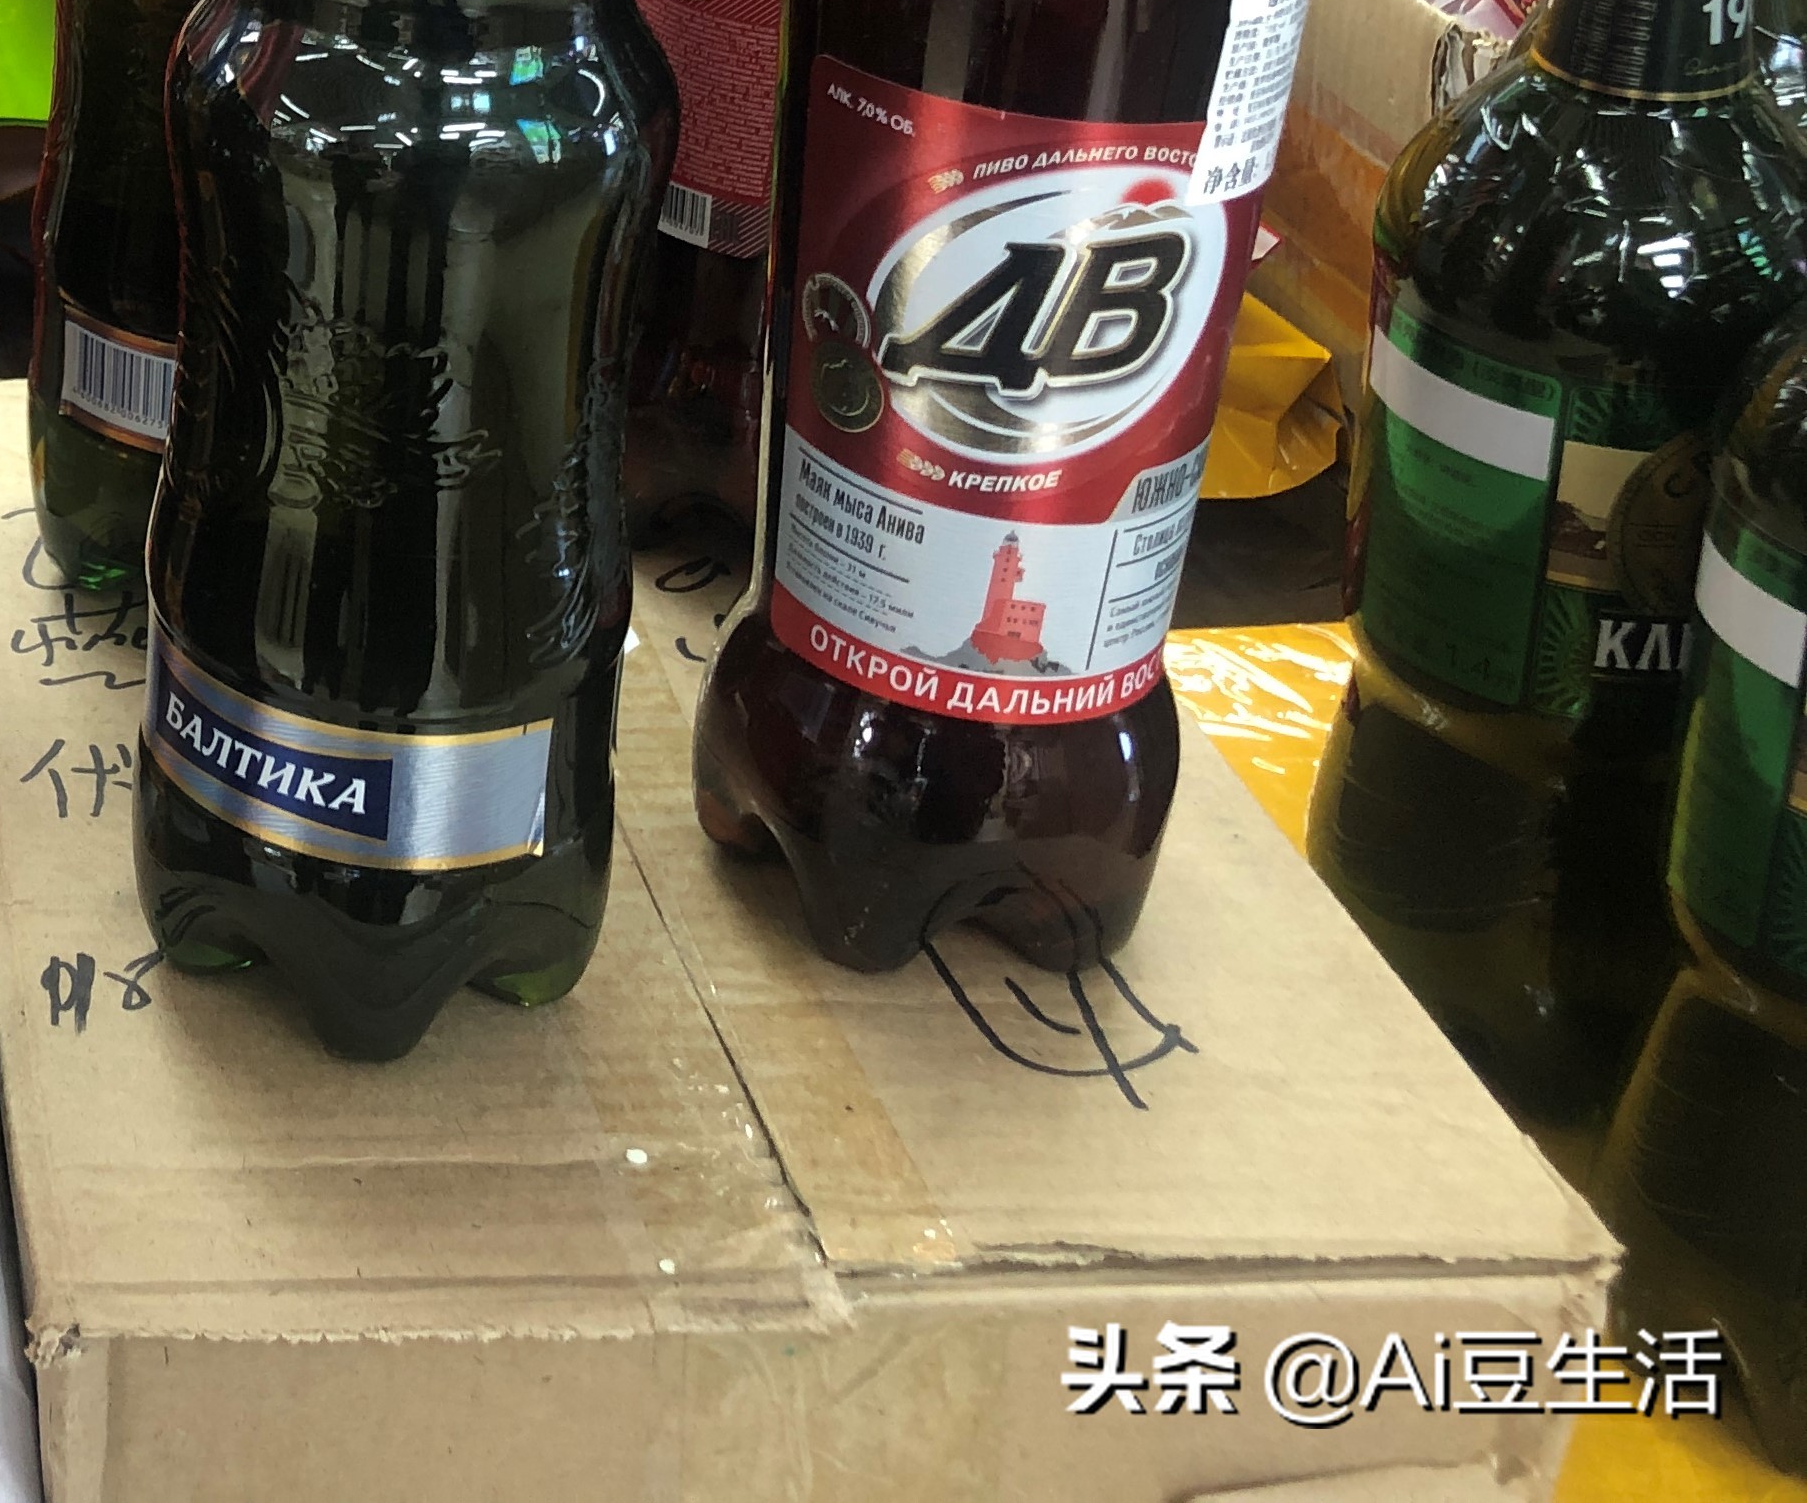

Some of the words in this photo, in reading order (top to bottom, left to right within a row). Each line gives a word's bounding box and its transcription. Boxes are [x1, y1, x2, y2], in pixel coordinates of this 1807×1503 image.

[825, 81, 854, 110] АЛК.
[856, 96, 890, 125] 7,0%
[973, 153, 1029, 180] ПИВО
[1031, 144, 1140, 170] ДАЛЬНЕГО
[880, 227, 1194, 401] ДВ
[798, 457, 833, 503] Маяк
[833, 488, 874, 525] мыса
[875, 505, 926, 545] Анива
[946, 468, 1063, 495] КРЕПКОЕ
[845, 524, 874, 554] 1939
[809, 623, 937, 703] ОТКРОЙ
[946, 675, 1114, 717] ДАЛЬНИЙ
[163, 689, 369, 816] БАЛТИКА
